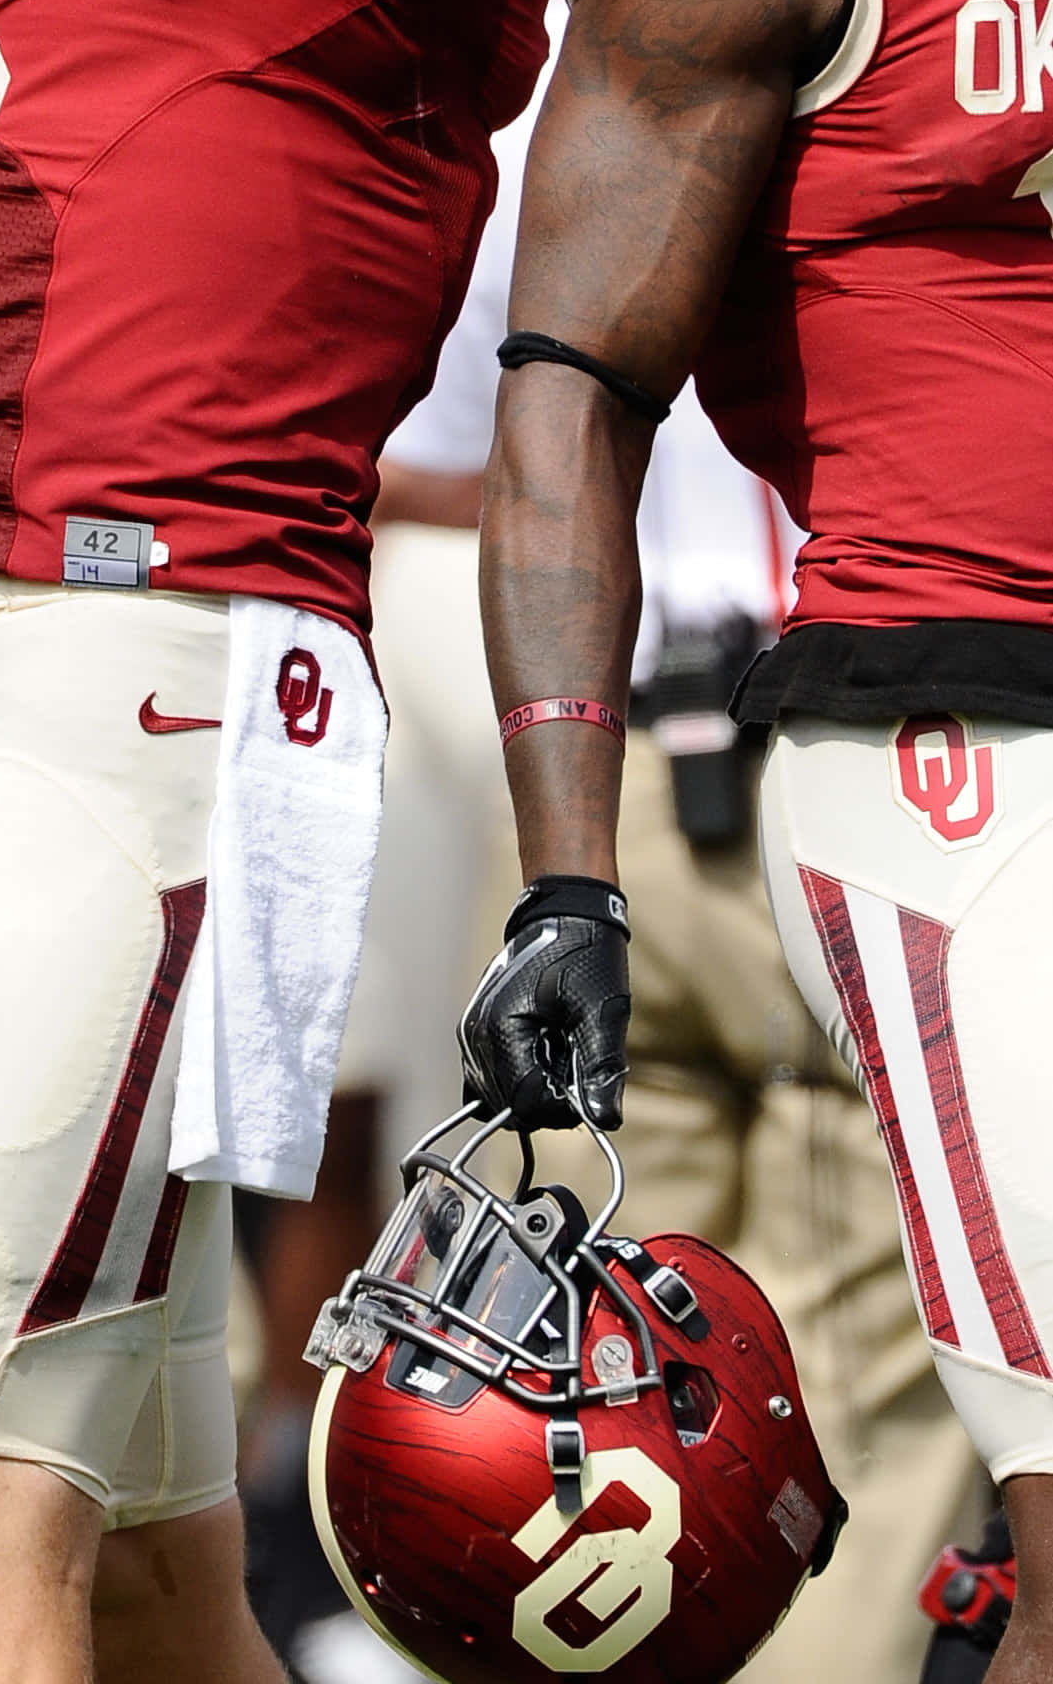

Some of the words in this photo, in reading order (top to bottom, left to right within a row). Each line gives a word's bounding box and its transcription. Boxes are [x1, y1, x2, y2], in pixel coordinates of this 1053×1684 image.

[82, 563, 99, 581] 14
[83, 529, 119, 554] 42
[276, 647, 334, 748] OU
[894, 715, 995, 842] OU
